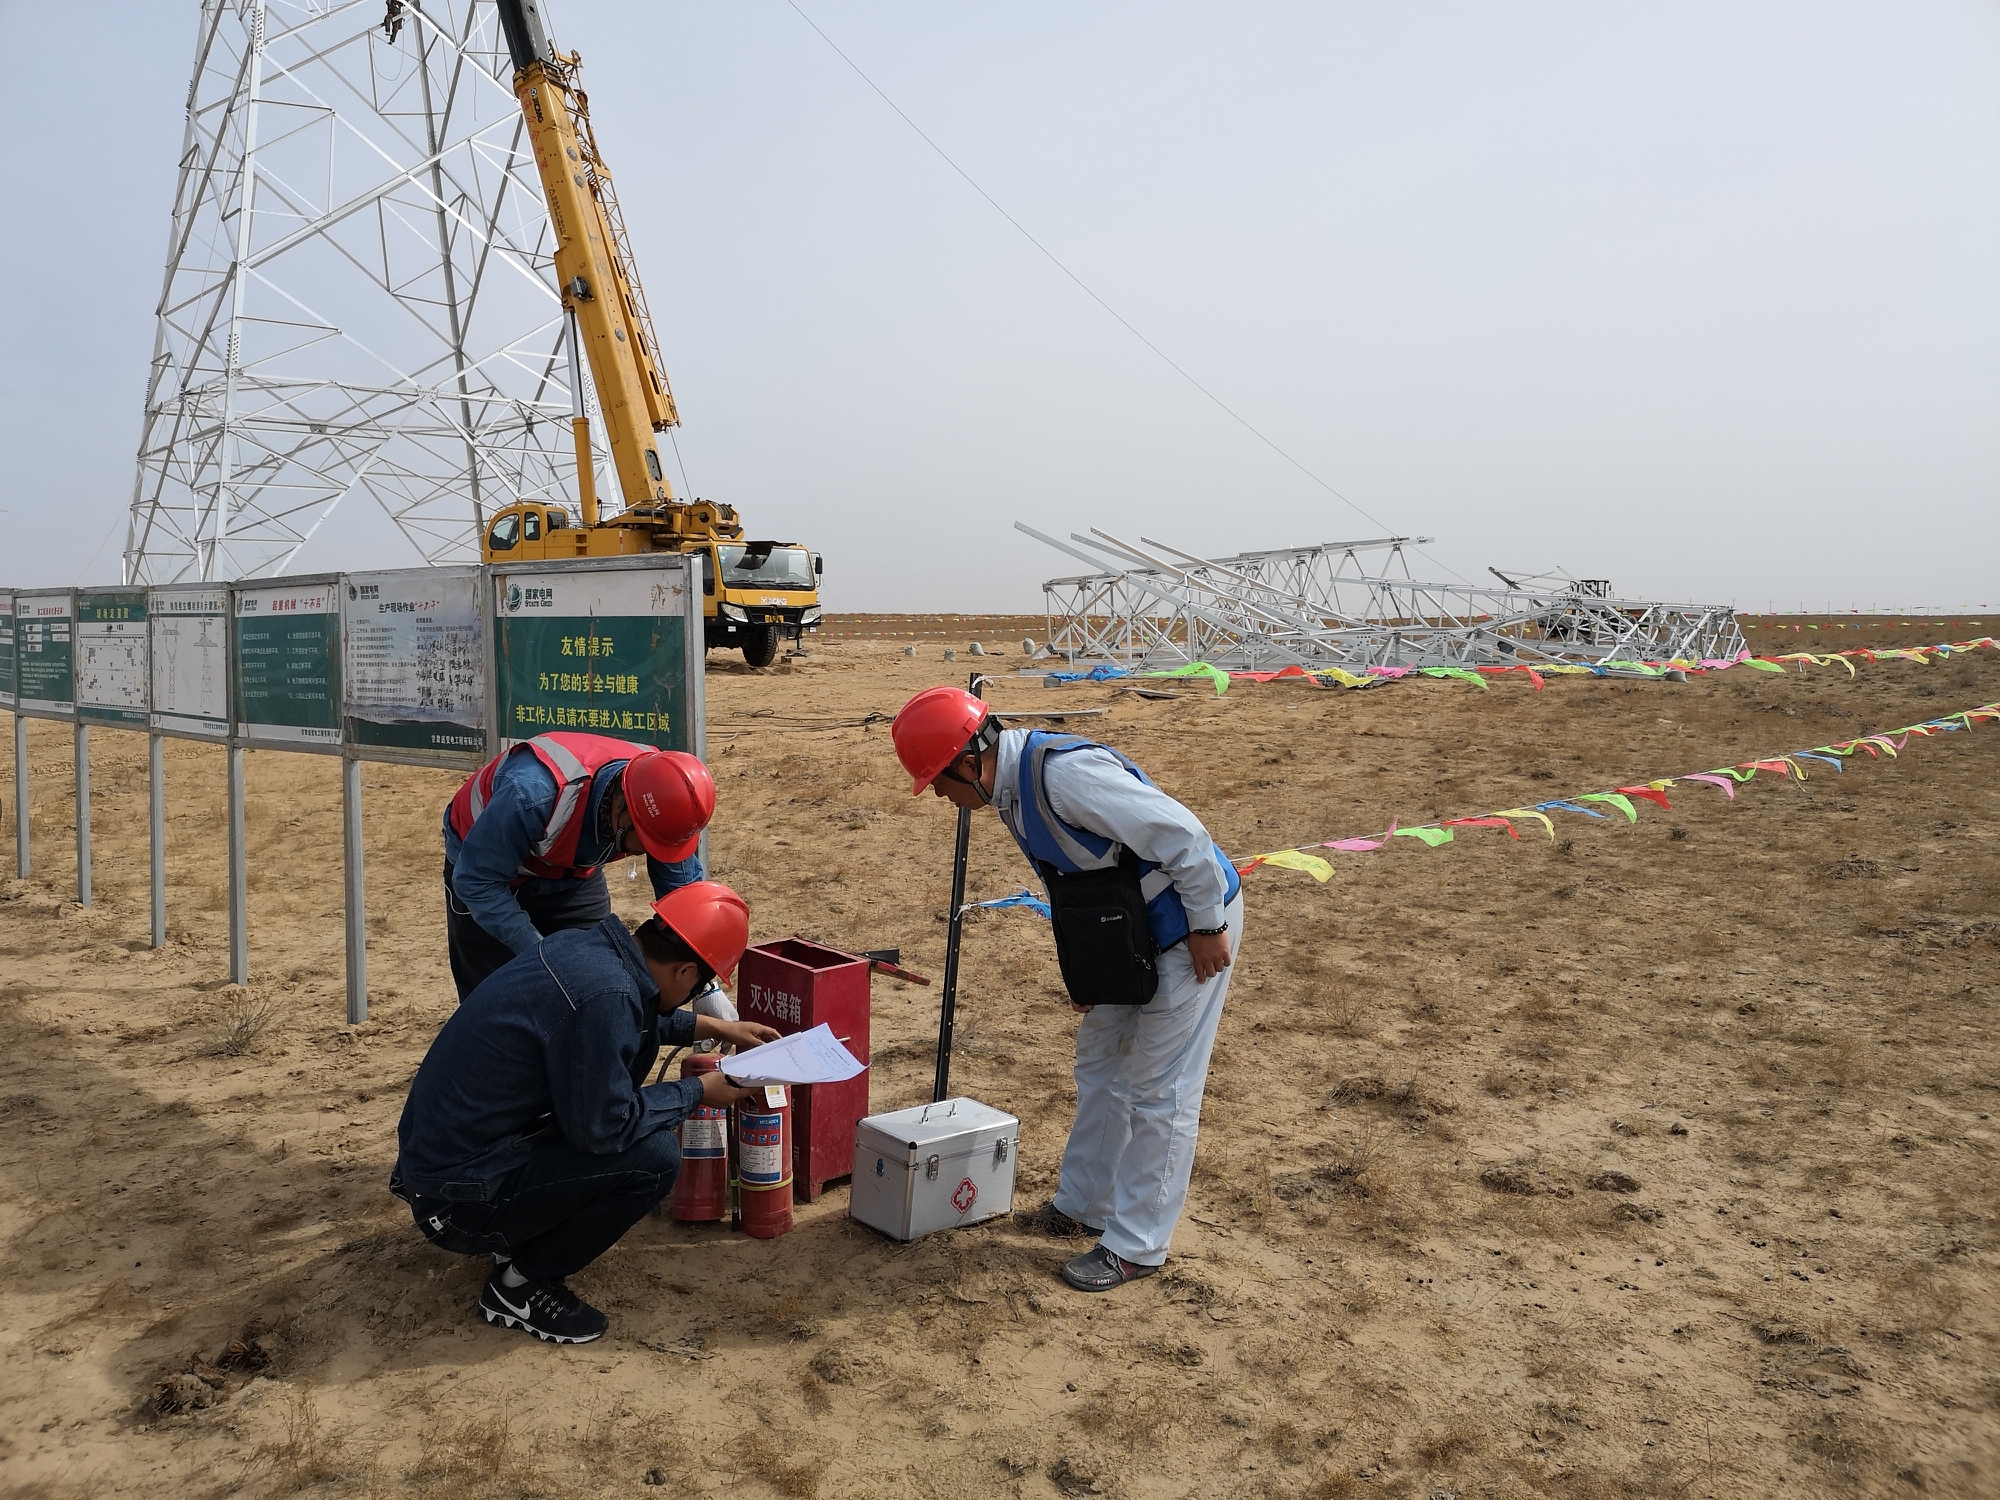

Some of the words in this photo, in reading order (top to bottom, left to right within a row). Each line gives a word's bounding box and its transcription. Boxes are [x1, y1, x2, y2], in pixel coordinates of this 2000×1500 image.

[532, 97, 544, 123] XCMG
[525, 588, 553, 600] 国家电网
[561, 636, 614, 657] 友情提示
[539, 672, 639, 695] 为了您的安全与健康
[516, 704, 670, 732] 非工作人员请不要进入施工区域
[750, 983, 801, 1025] 灭火器箱
